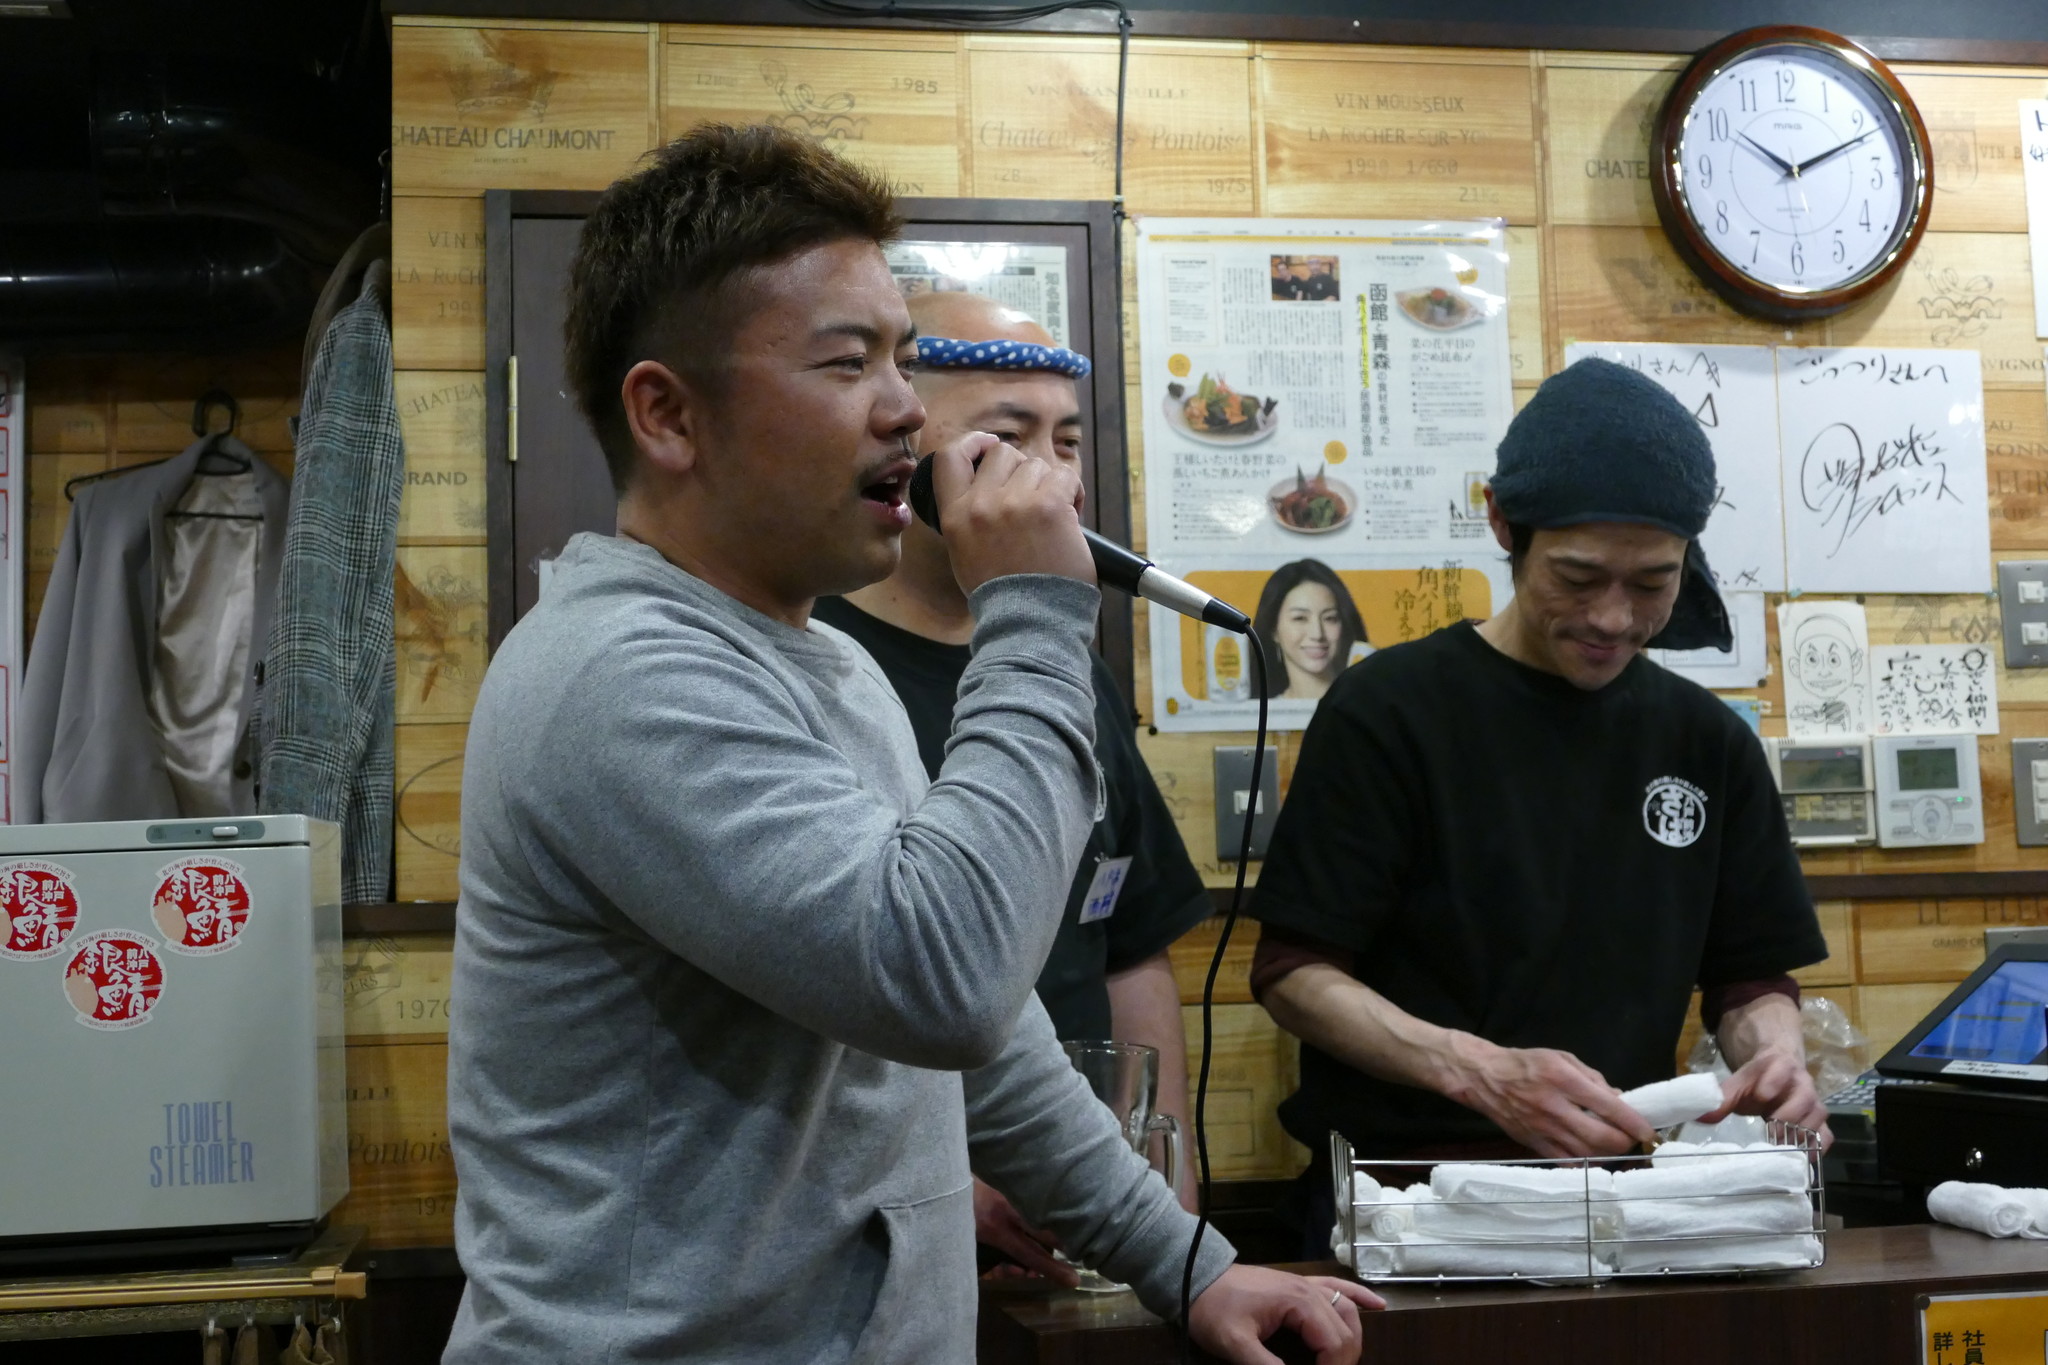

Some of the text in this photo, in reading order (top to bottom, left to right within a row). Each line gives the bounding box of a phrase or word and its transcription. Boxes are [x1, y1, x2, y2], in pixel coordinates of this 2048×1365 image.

[890, 76, 938, 95] 1985
[1739, 79, 1758, 112] 11
[1776, 68, 1796, 103] 12
[1821, 80, 1829, 113] 1
[1335, 93, 1466, 114] VIN MOUSSEUX
[494, 127, 615, 151] CHAUMONT
[1708, 107, 1729, 142] 10
[1852, 109, 1865, 144] 2
[1699, 154, 1712, 189] 9
[1870, 156, 1883, 190] 3
[1716, 199, 1729, 235] 8
[1858, 199, 1871, 233] 4
[428, 230, 466, 249] VIN
[1750, 230, 1760, 264] 7
[1832, 229, 1845, 264] 5
[1791, 241, 1804, 276] 6
[162, 1100, 238, 1145] TOWEL
[150, 1141, 255, 1189] STEAMER
